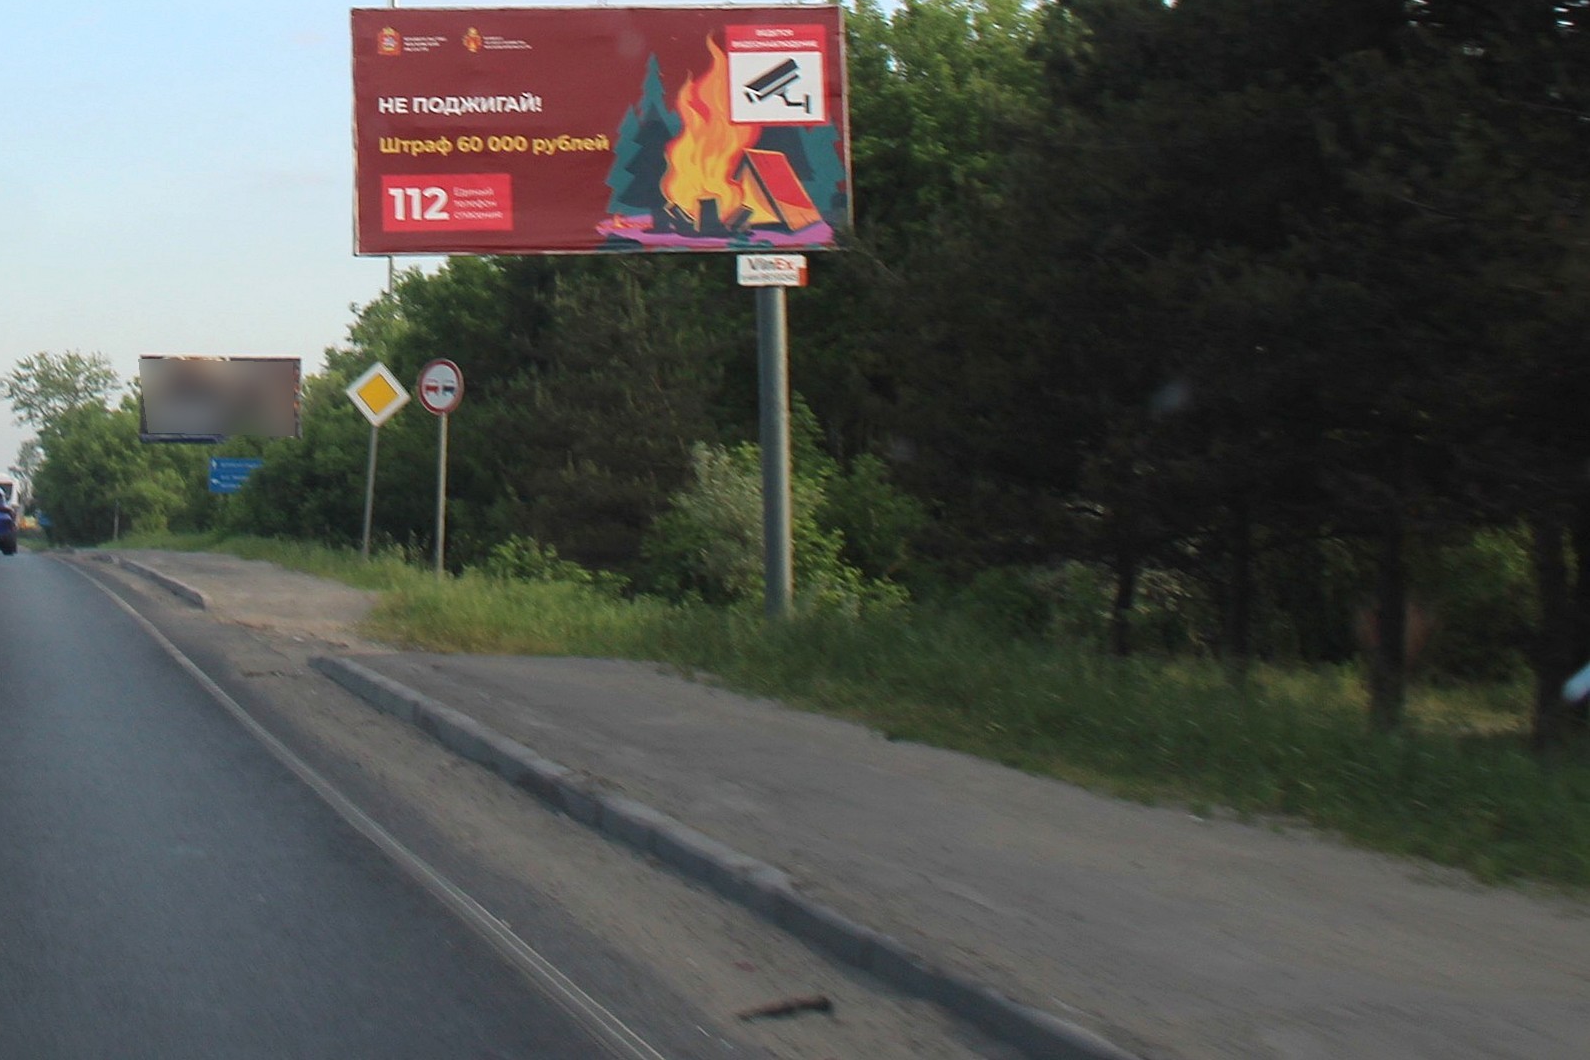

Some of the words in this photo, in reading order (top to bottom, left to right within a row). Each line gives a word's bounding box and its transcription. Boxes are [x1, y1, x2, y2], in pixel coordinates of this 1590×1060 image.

[378, 97, 409, 114] НЕ
[412, 92, 543, 116] ПОДЖИГАЙ!
[379, 136, 453, 157] Штраф
[457, 136, 484, 153] 60
[487, 135, 528, 152] 000
[532, 133, 610, 156] рублей
[388, 186, 450, 221] 112
